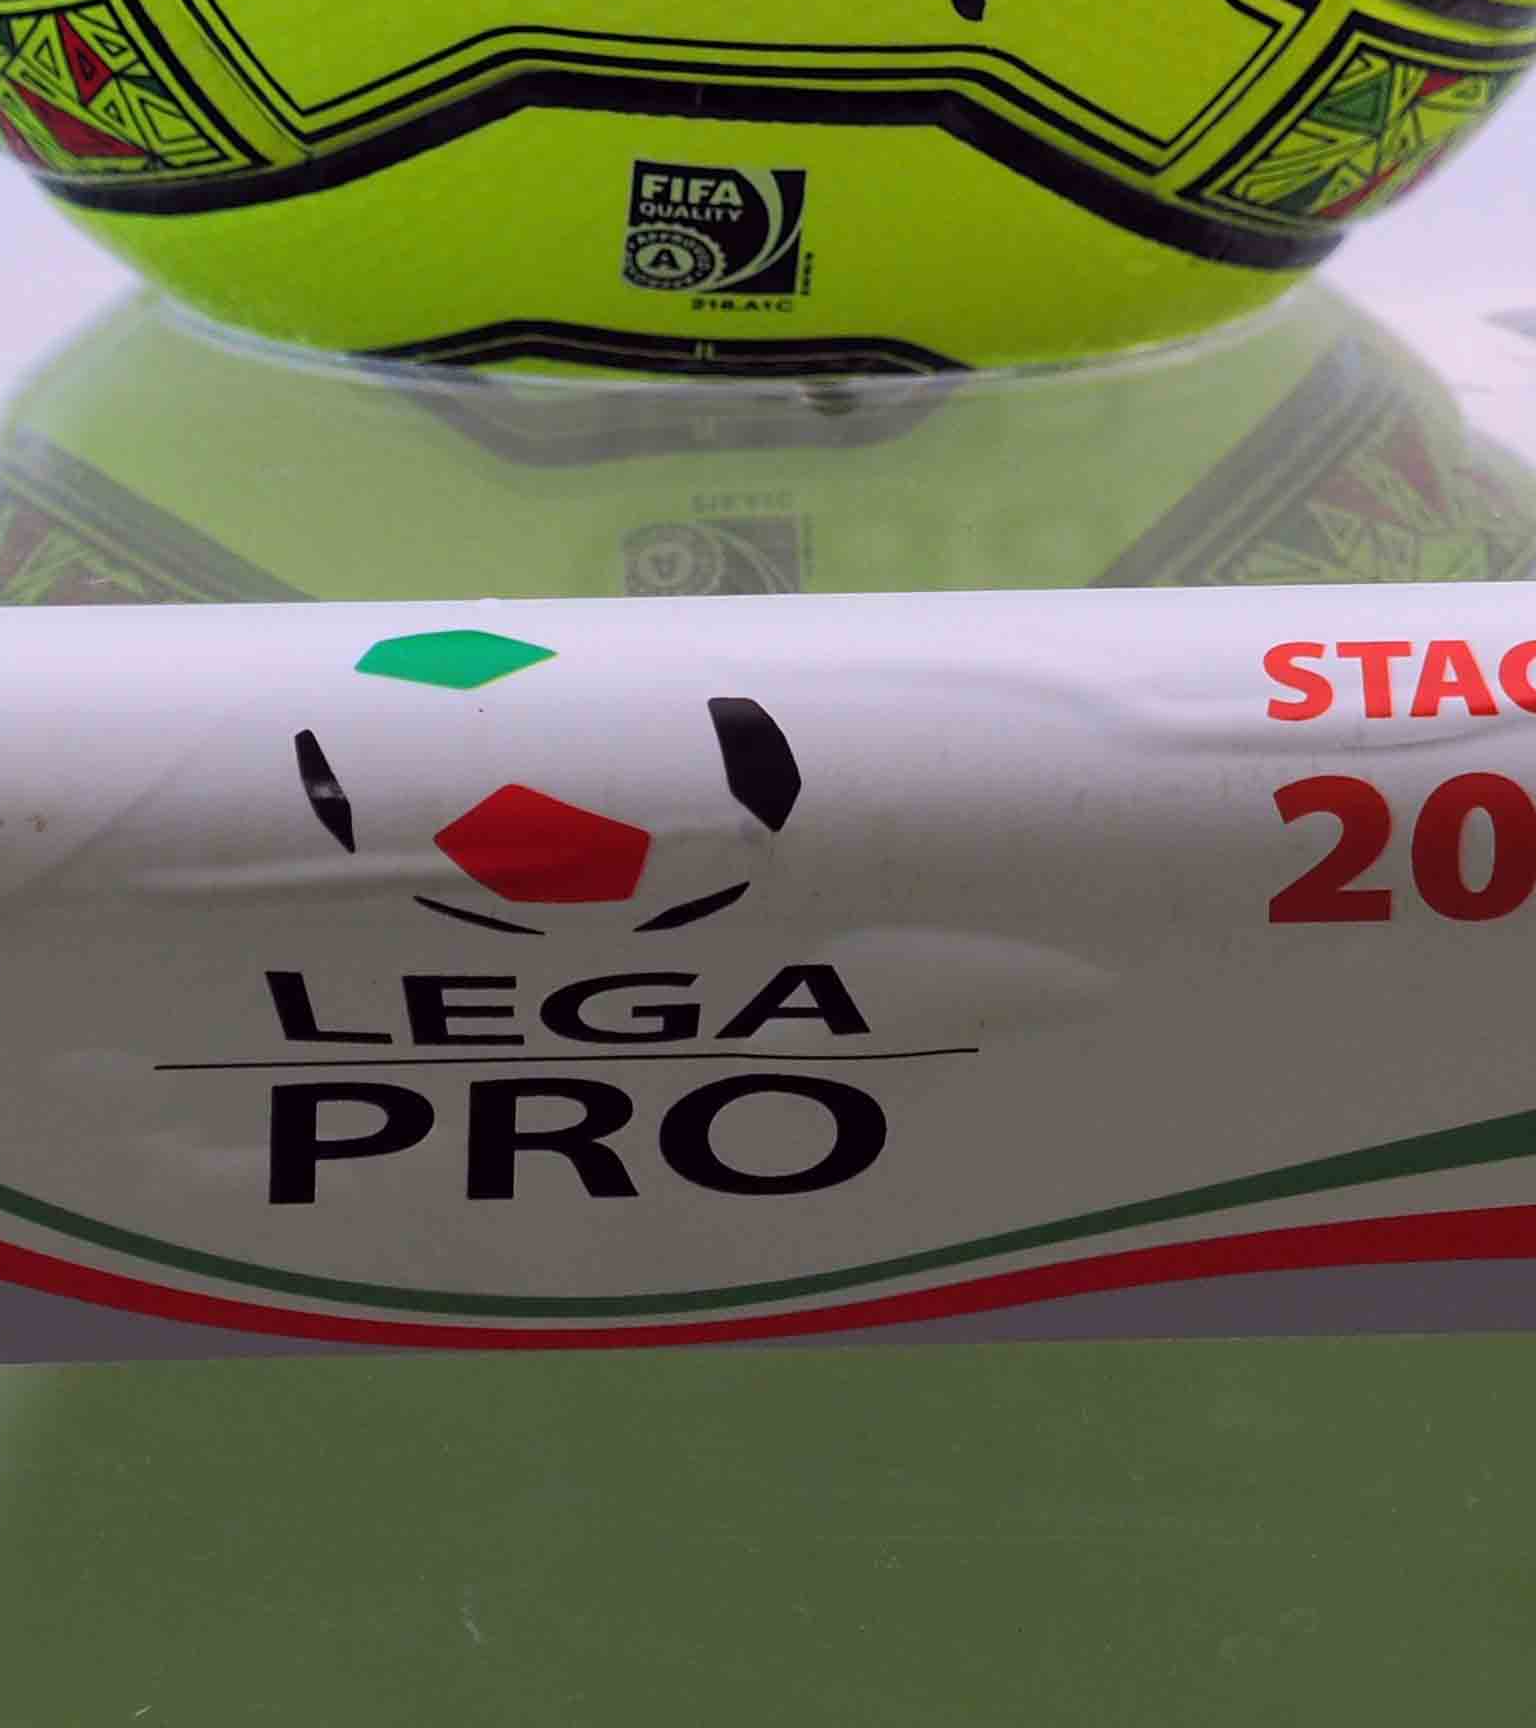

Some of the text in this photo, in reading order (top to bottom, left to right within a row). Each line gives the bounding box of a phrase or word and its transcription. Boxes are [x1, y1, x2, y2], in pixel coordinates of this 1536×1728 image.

[640, 174, 743, 207] FIFA
[638, 203, 744, 221] QUALITY
[650, 249, 681, 271] A
[265, 963, 871, 1045] LEGA
[269, 1073, 887, 1204] PRO
